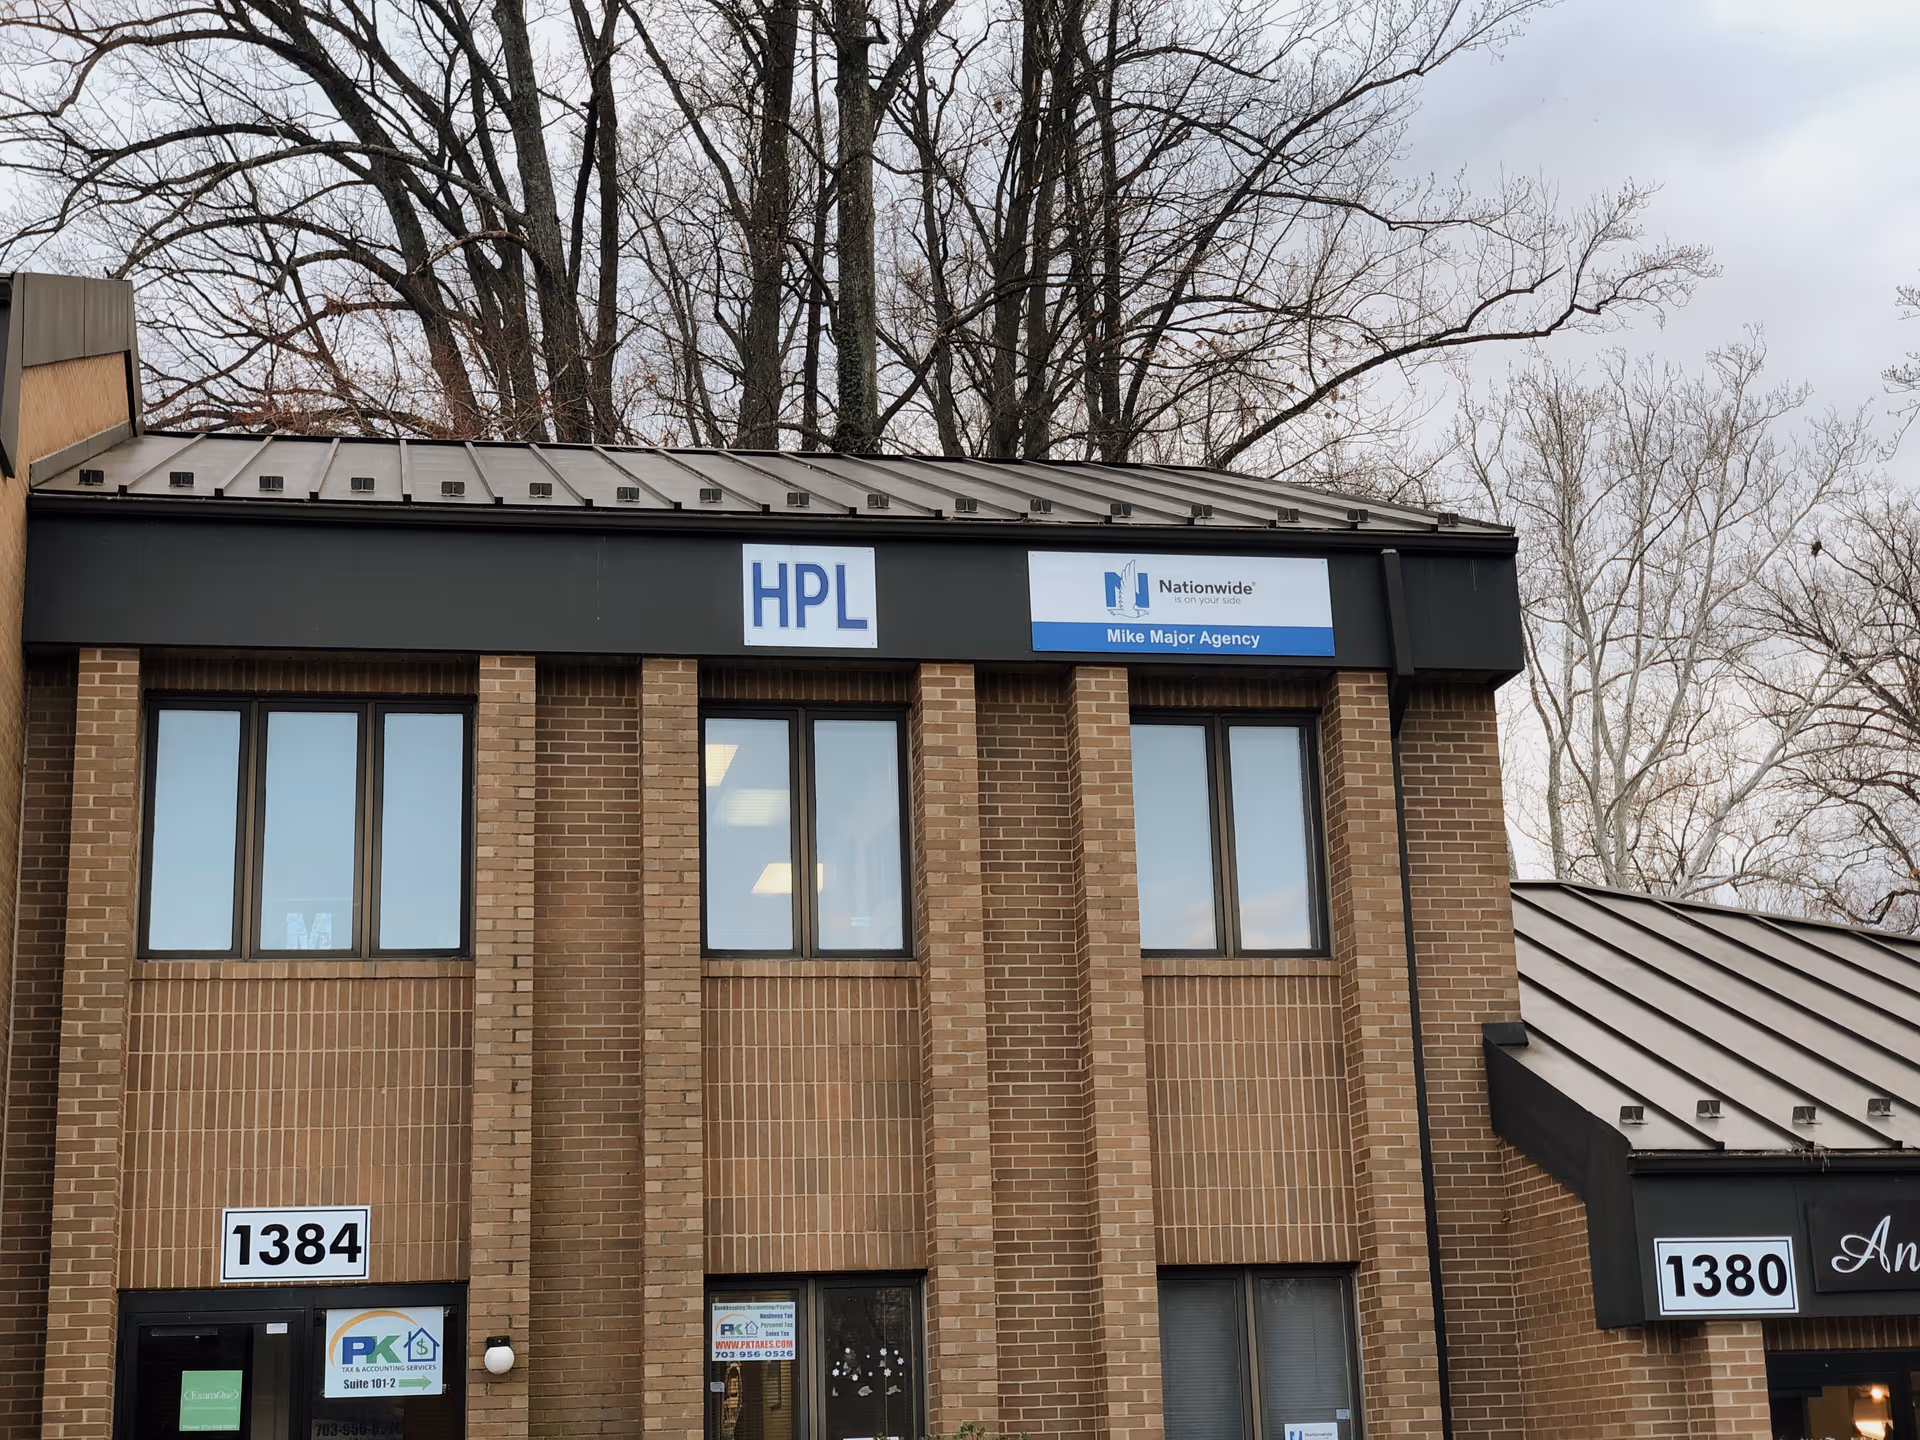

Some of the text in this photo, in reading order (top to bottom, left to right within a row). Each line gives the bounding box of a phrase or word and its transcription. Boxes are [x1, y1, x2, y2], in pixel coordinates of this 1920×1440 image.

[751, 560, 869, 631] HPL
[1159, 580, 1253, 595] Nationwide
[1174, 596, 1182, 604] is
[1199, 597, 1220, 606] your
[1222, 596, 1241, 605] side
[1107, 629, 1261, 648] Mike Major Agency
[232, 1223, 362, 1266] 1384
[1665, 1253, 1788, 1298] 1380
[720, 1323, 744, 1335] PK
[342, 1335, 402, 1365] PK
[715, 1340, 793, 1349] WWW.PKTAXES.COM
[343, 1377, 396, 1389] Suite 101-2
